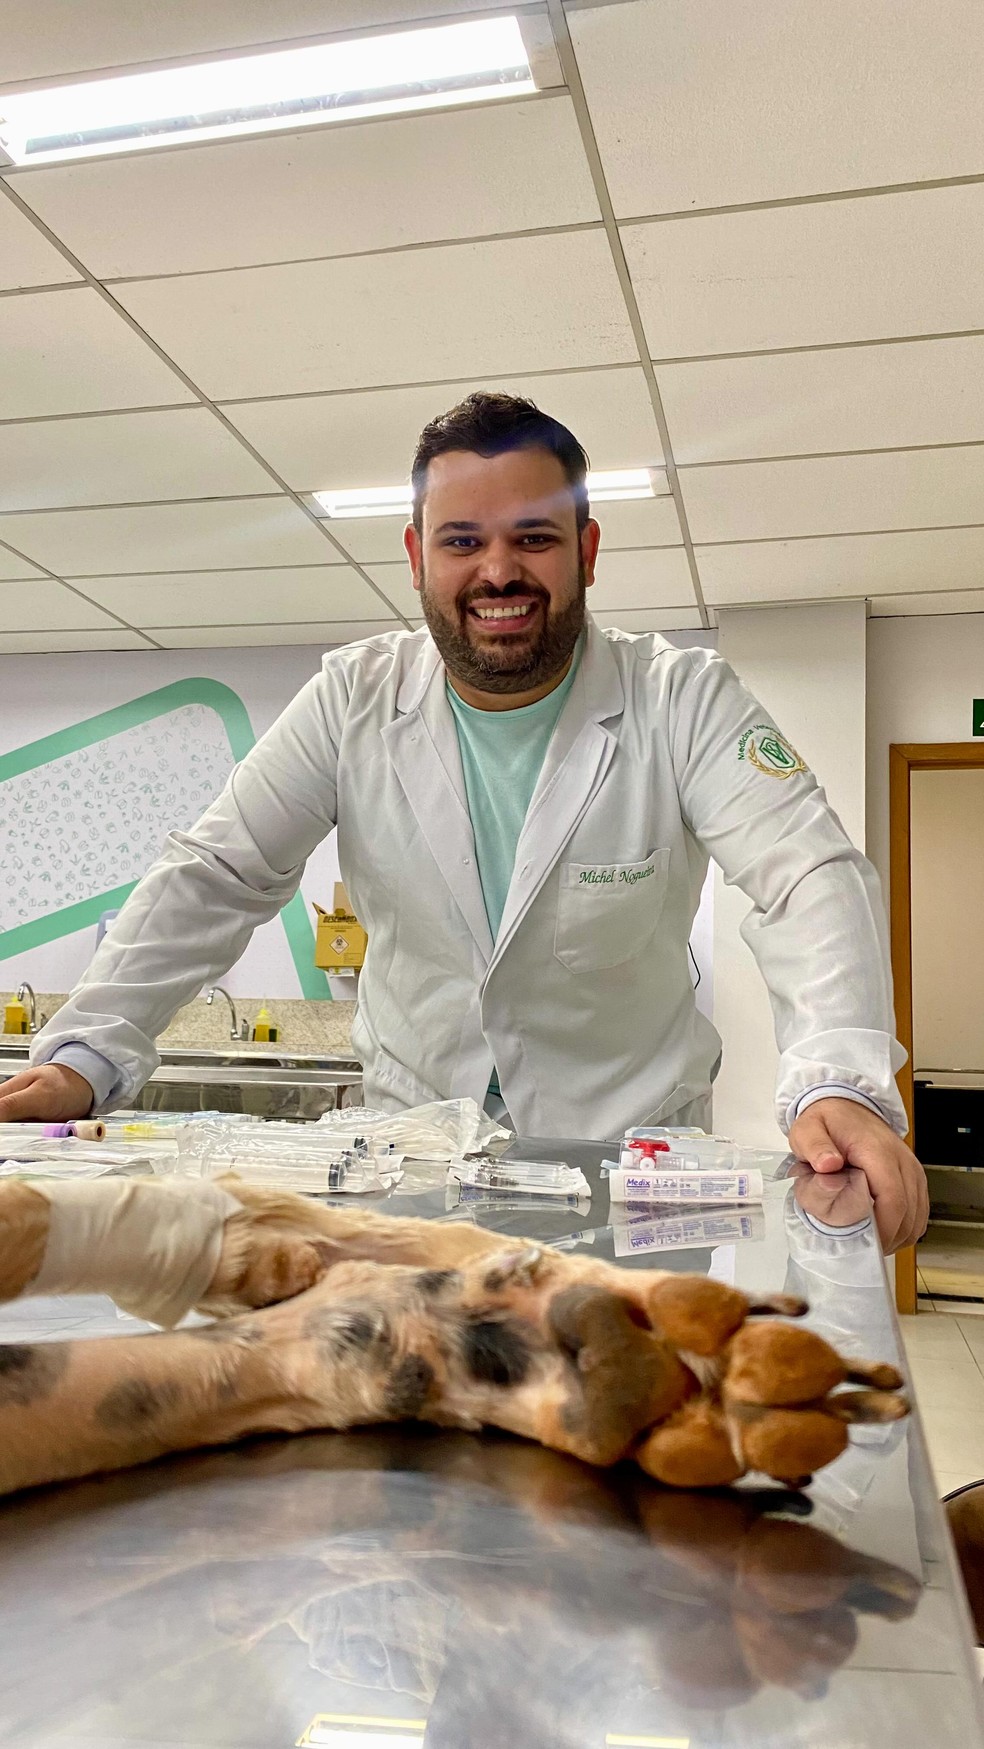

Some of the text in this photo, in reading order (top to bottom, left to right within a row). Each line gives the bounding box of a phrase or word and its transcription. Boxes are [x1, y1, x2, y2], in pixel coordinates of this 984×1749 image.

[737, 729, 754, 760] Medicina
[579, 870, 617, 883] Michel
[626, 1178, 650, 1186] Medix
